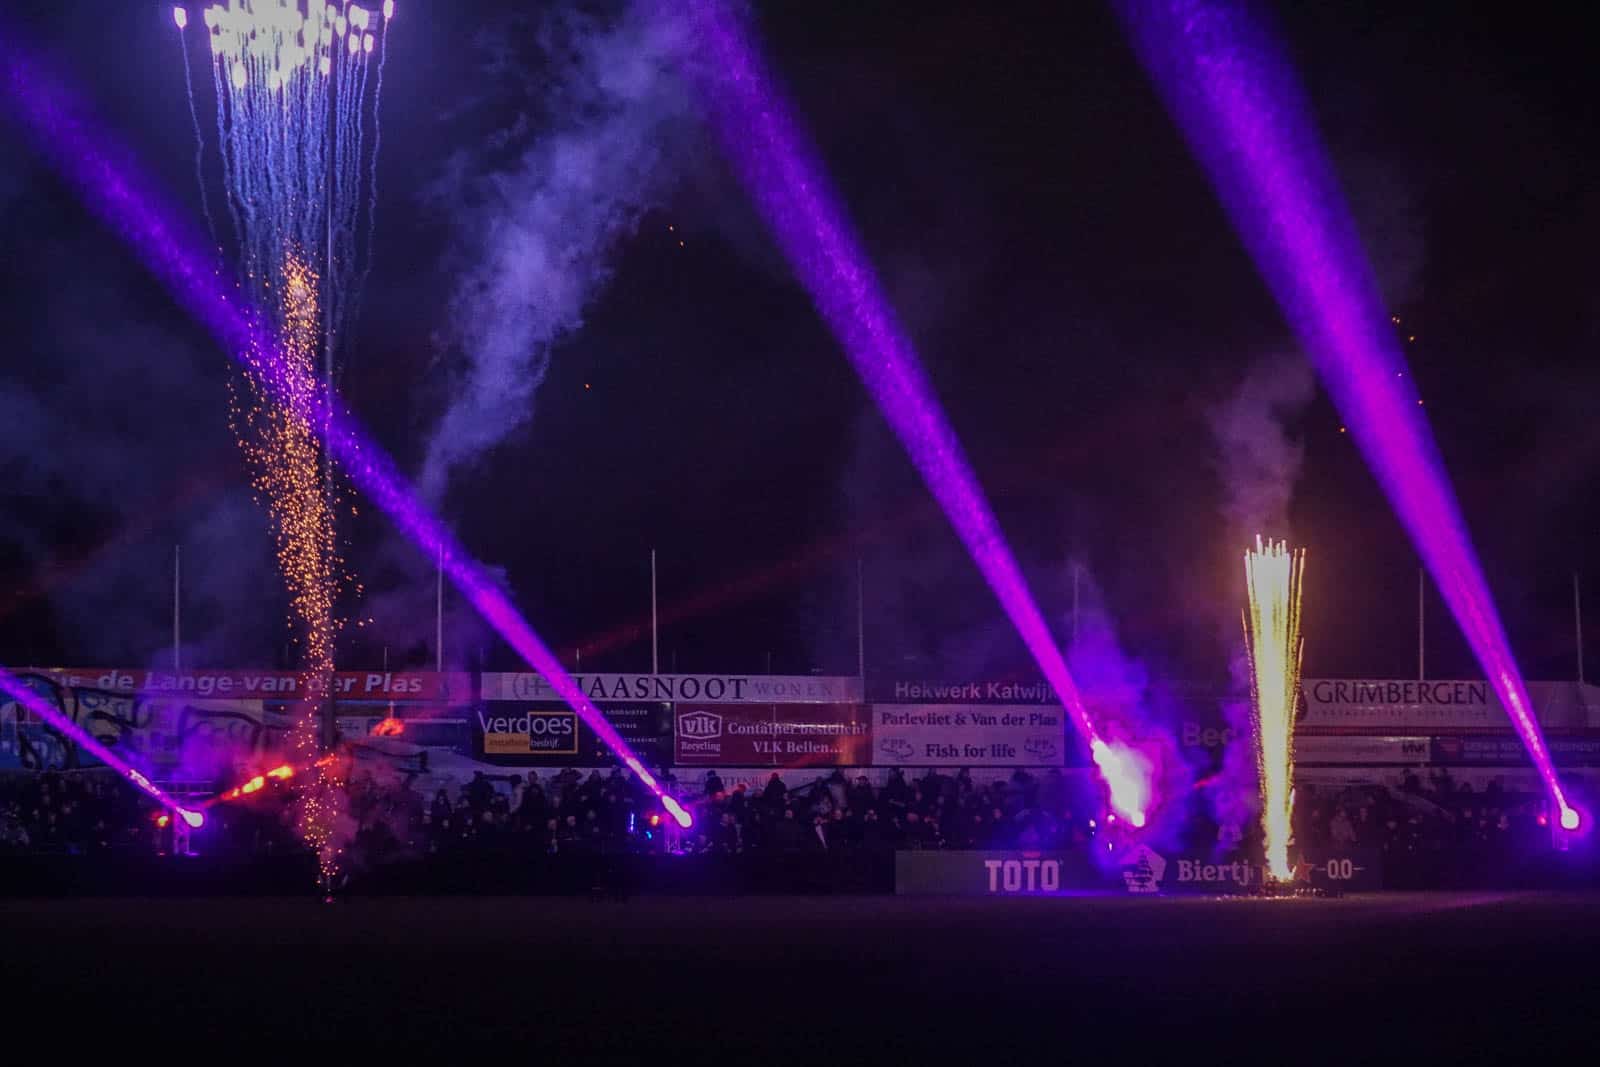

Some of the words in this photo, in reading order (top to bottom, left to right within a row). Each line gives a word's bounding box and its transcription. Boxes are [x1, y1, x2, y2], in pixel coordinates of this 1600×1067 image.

[98, 670, 134, 688] de
[364, 672, 423, 692] Plas
[561, 677, 748, 699] AASNOOT
[895, 682, 981, 698] Hekwerk
[1314, 681, 1487, 705] GRIMBERGEN
[881, 713, 949, 726] Parlevliet
[955, 714, 966, 726] &
[970, 713, 997, 726] Van
[1002, 713, 1025, 726] der
[1030, 713, 1057, 726] Plas
[753, 741, 782, 753] VLK
[926, 744, 959, 758] Fish
[965, 744, 986, 758] for
[992, 744, 1016, 758] life
[985, 860, 1059, 891] TOTO
